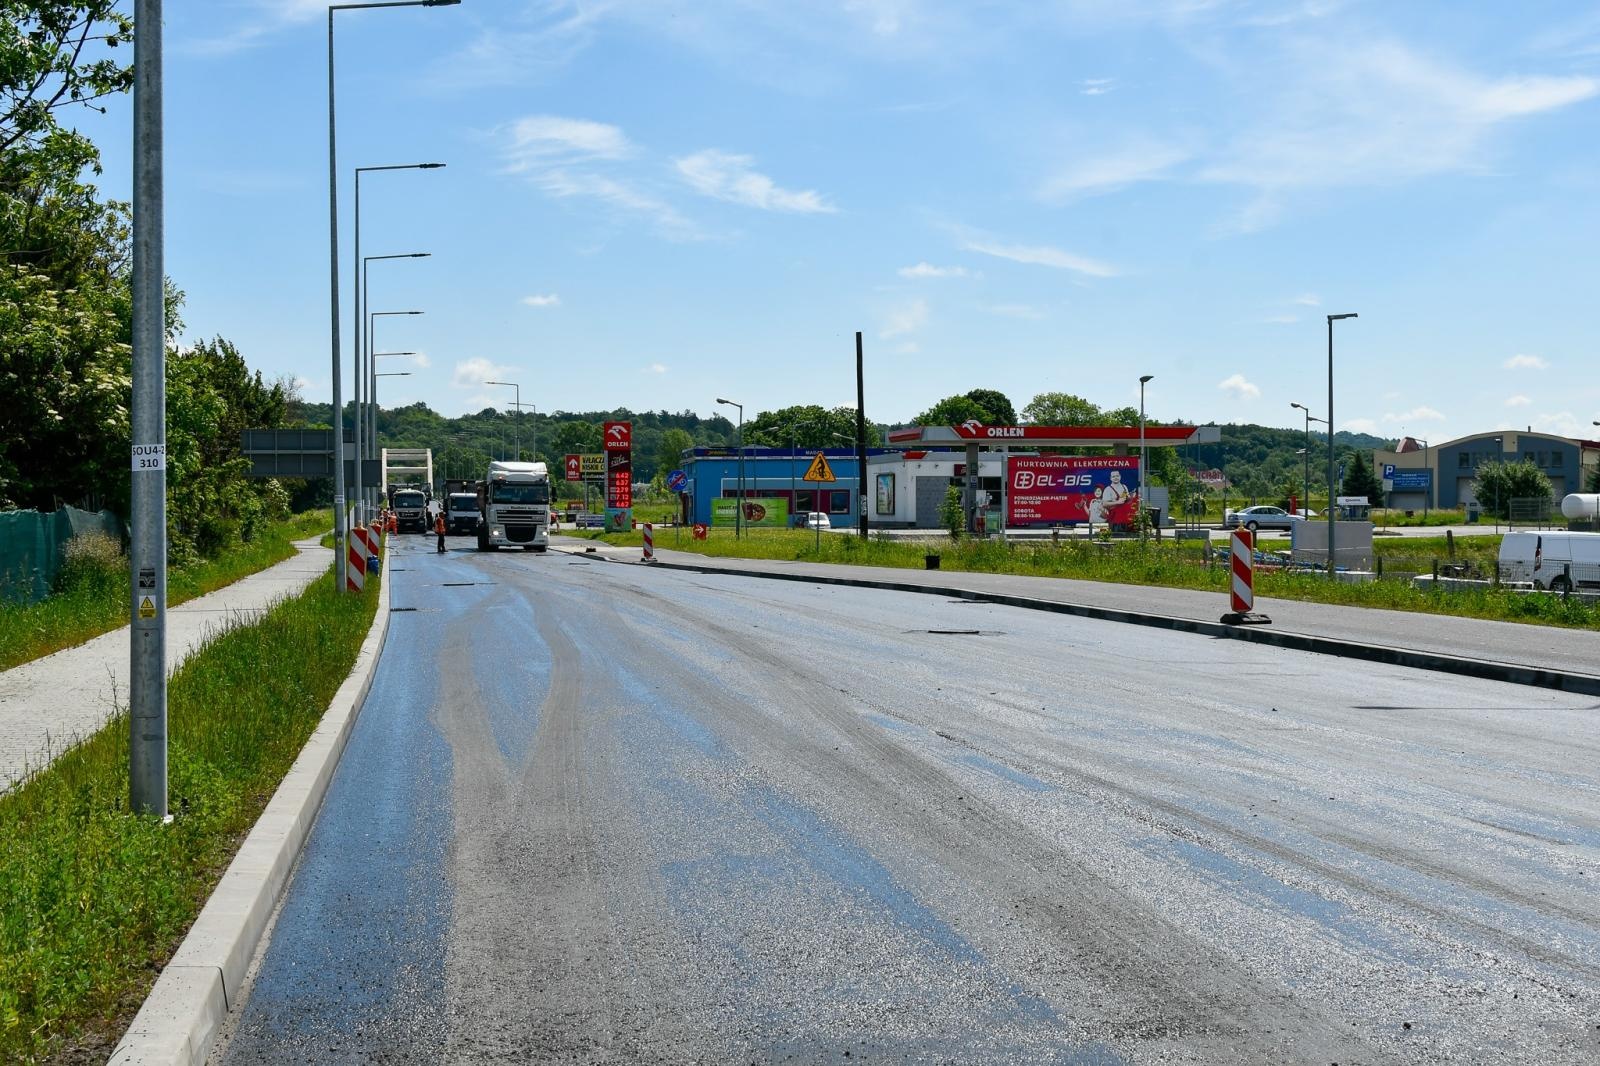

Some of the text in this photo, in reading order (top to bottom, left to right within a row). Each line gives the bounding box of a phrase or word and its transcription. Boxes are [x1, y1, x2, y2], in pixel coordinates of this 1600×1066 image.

[987, 428, 1024, 437] ORLEN
[140, 458, 159, 468] 310
[1386, 466, 1393, 475] P
